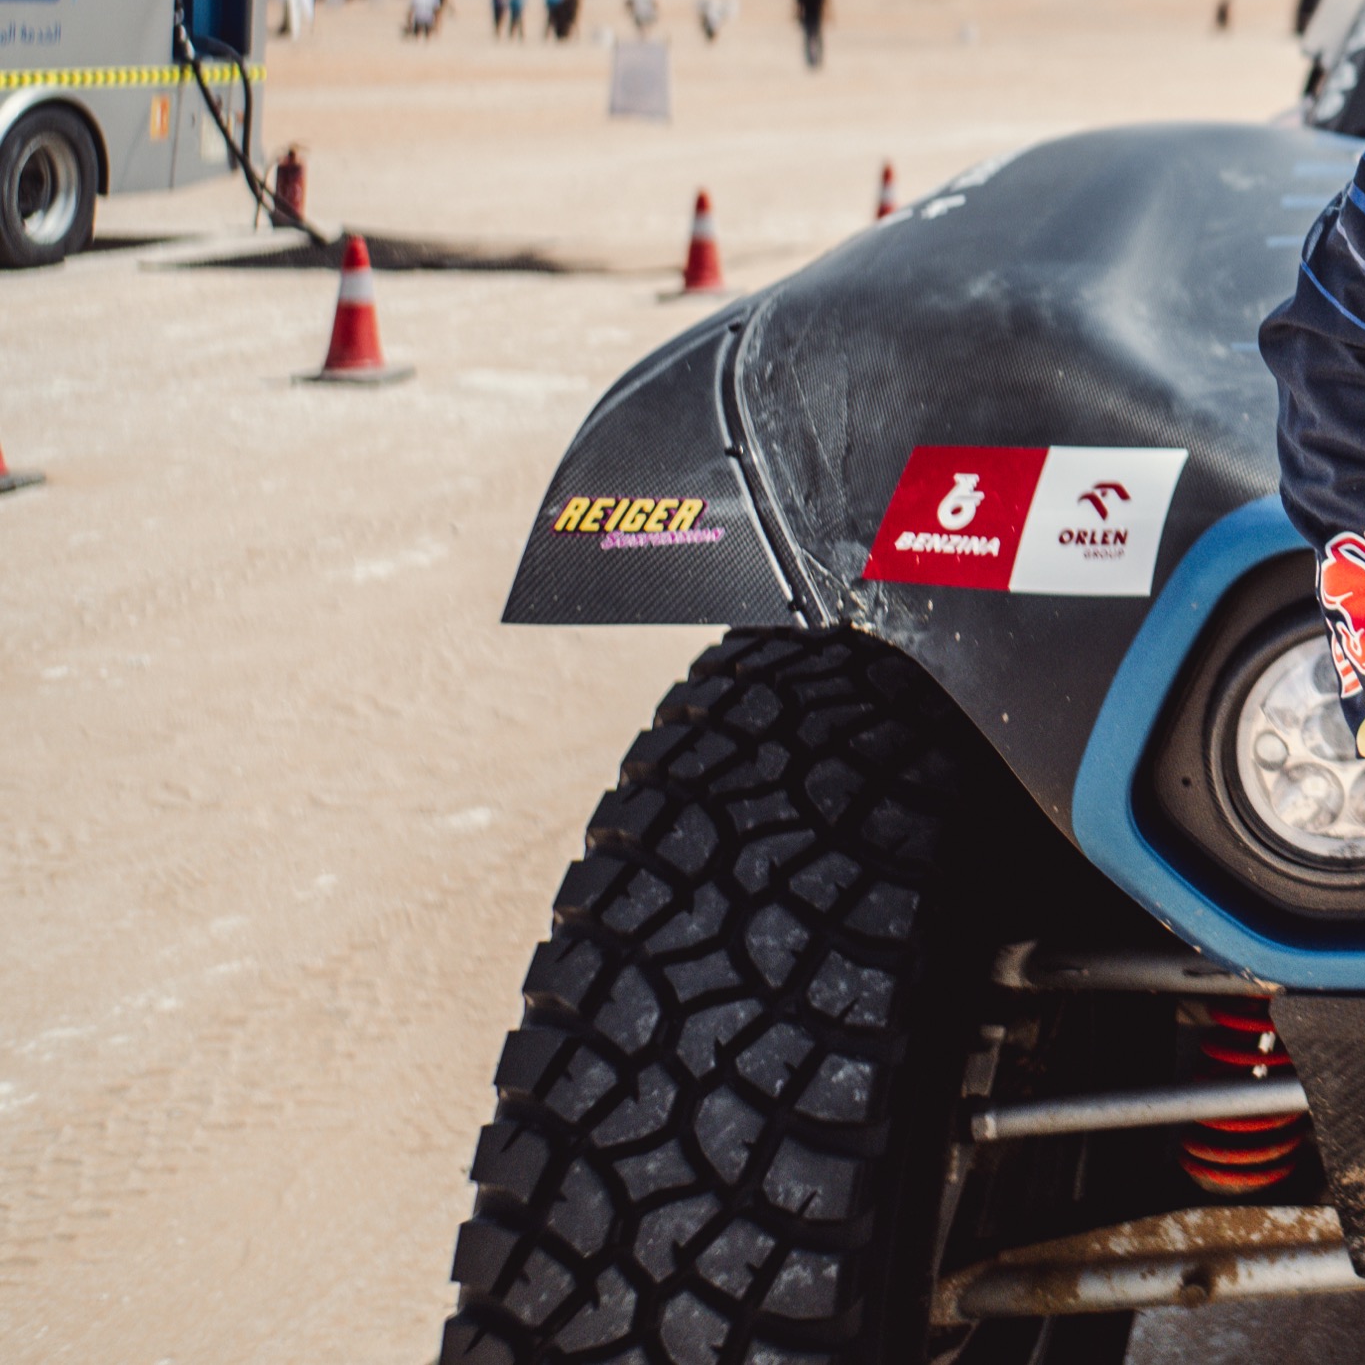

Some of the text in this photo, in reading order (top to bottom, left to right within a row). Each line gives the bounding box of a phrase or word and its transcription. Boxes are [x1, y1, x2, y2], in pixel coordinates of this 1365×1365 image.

[552, 495, 705, 533] REIGER
[894, 531, 1000, 557] BENZINA
[1058, 529, 1128, 546] ORLEN
[1083, 547, 1125, 560] GROUP
